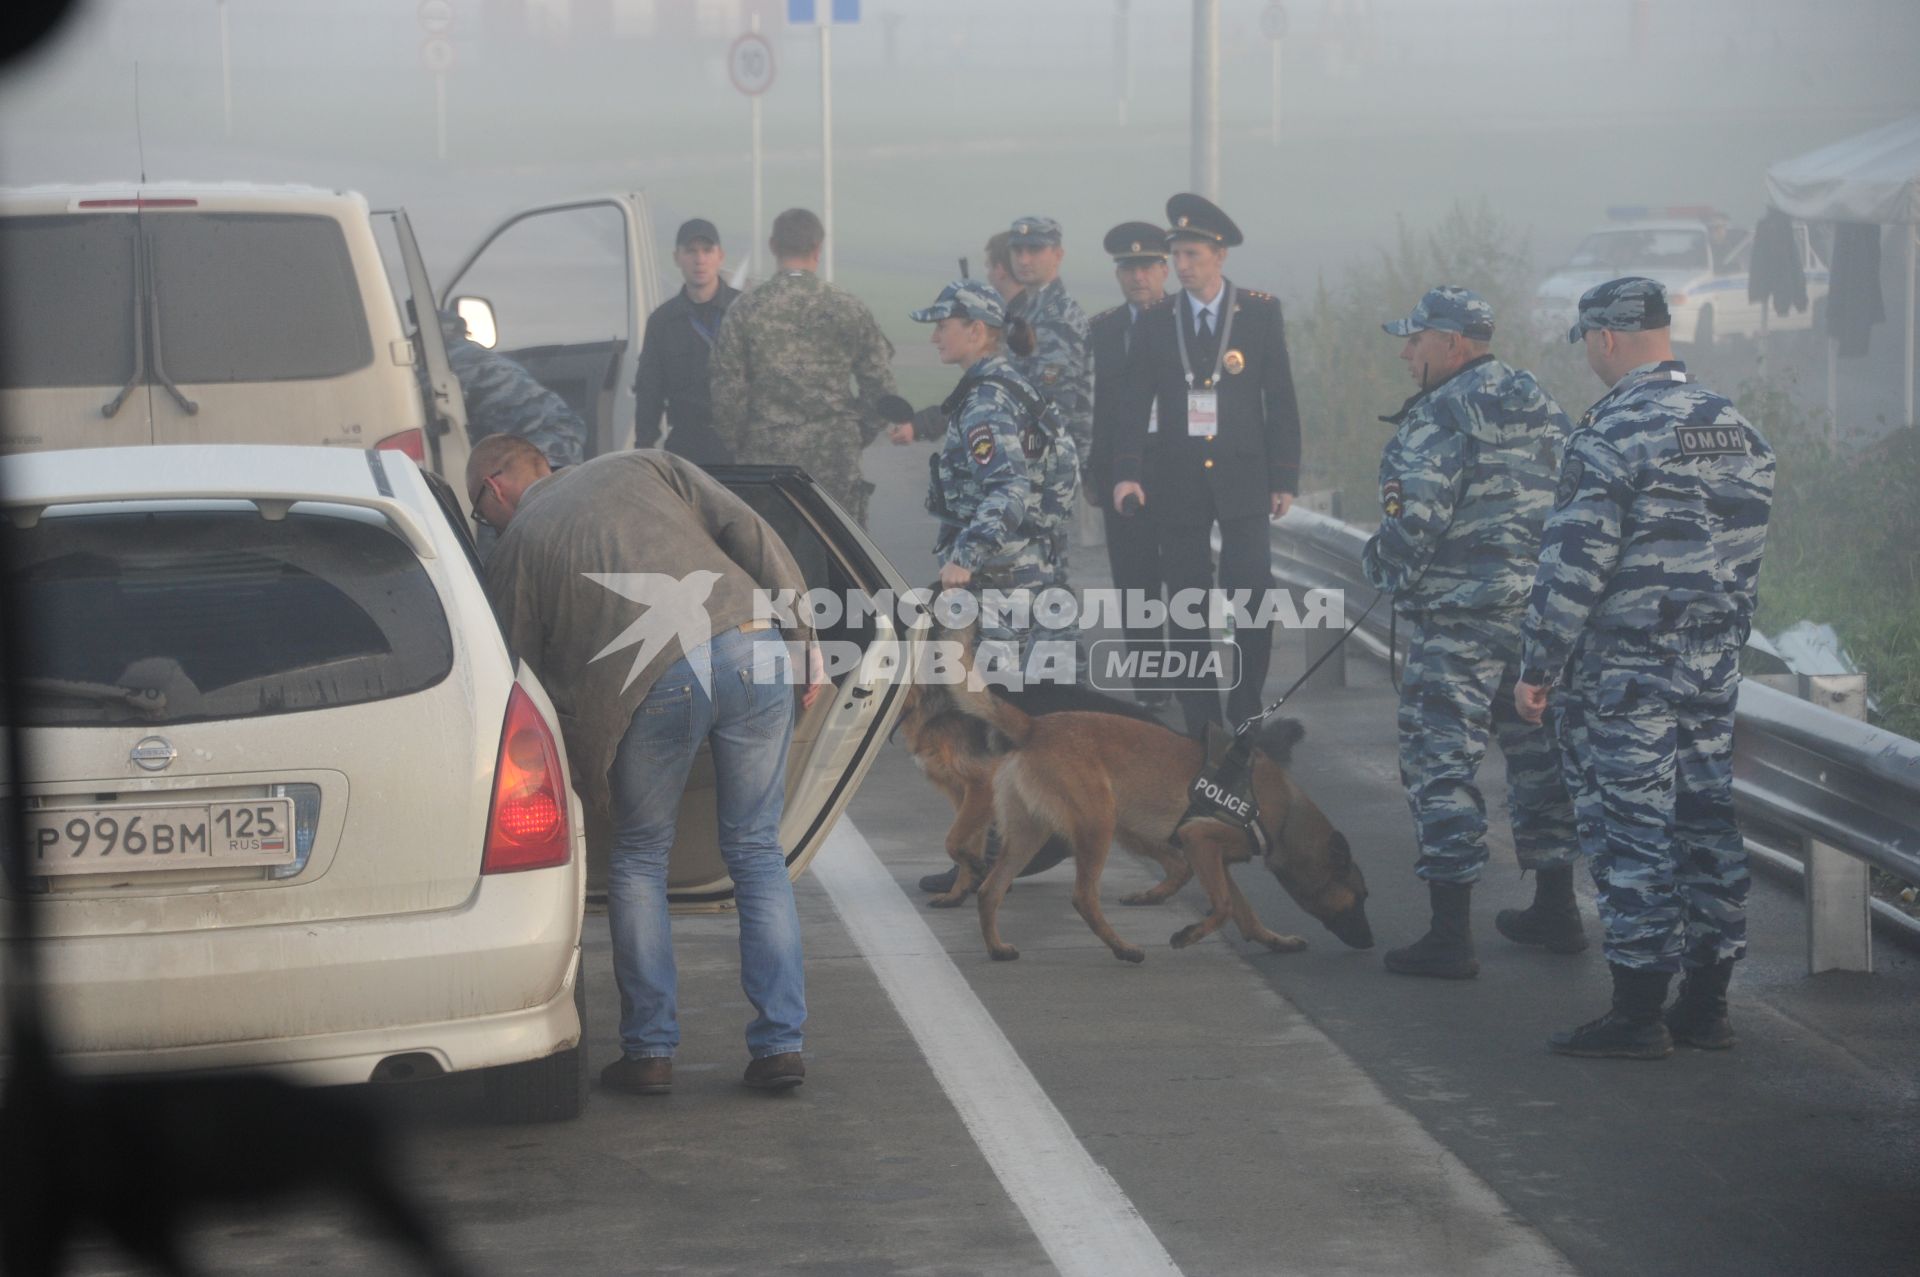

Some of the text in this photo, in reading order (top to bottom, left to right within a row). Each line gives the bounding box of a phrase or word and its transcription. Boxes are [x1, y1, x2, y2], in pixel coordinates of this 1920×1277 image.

[1683, 430, 1743, 450] ОМОН
[1194, 777, 1251, 817] POLICE
[37, 806, 277, 859] Р996ВМ 125
[229, 839, 260, 850] RUS
